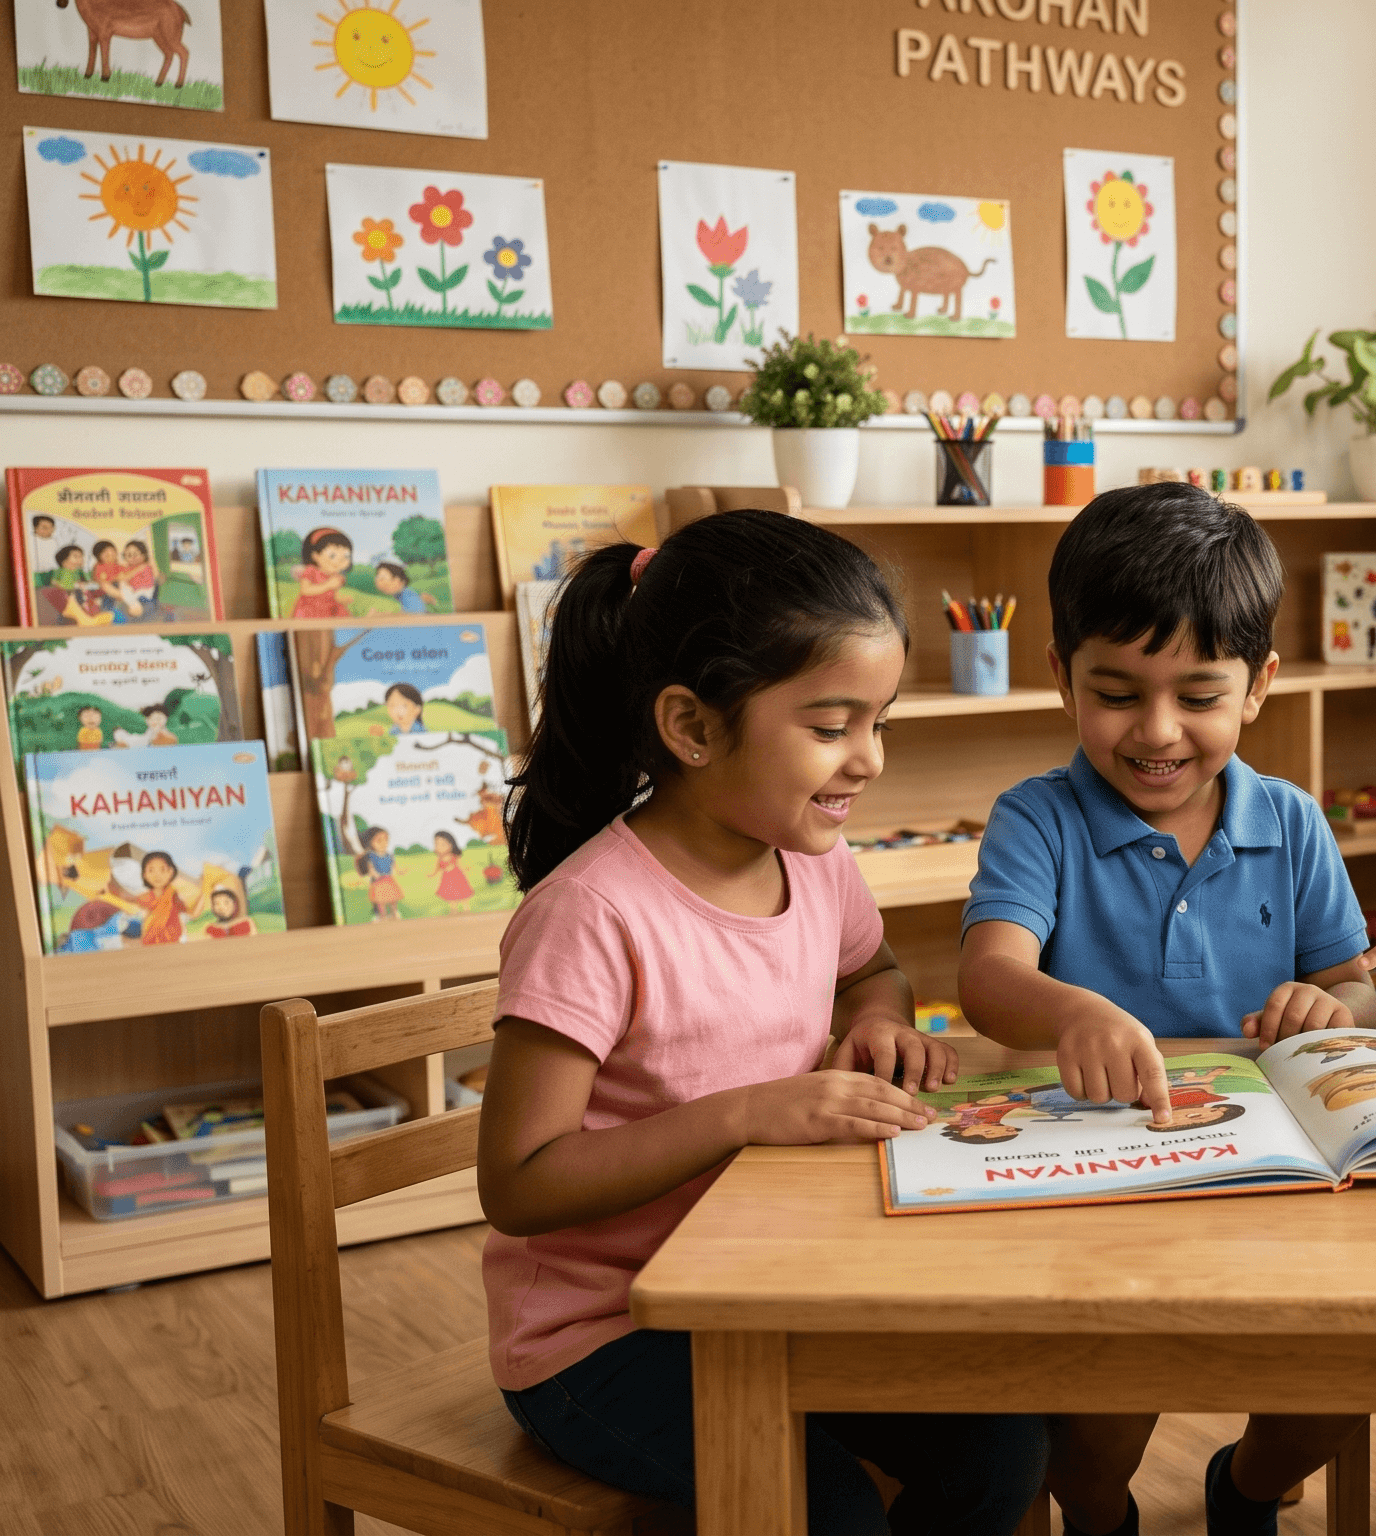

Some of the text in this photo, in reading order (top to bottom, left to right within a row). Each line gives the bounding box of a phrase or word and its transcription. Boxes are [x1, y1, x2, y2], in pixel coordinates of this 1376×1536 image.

[917, 0, 1149, 36] HAN
[897, 28, 1187, 107] PATHWAYS
[278, 483, 418, 504] KAHANIYAN
[70, 783, 245, 816] KAHANIYAN
[985, 1143, 1238, 1182] KAHANIYAN
